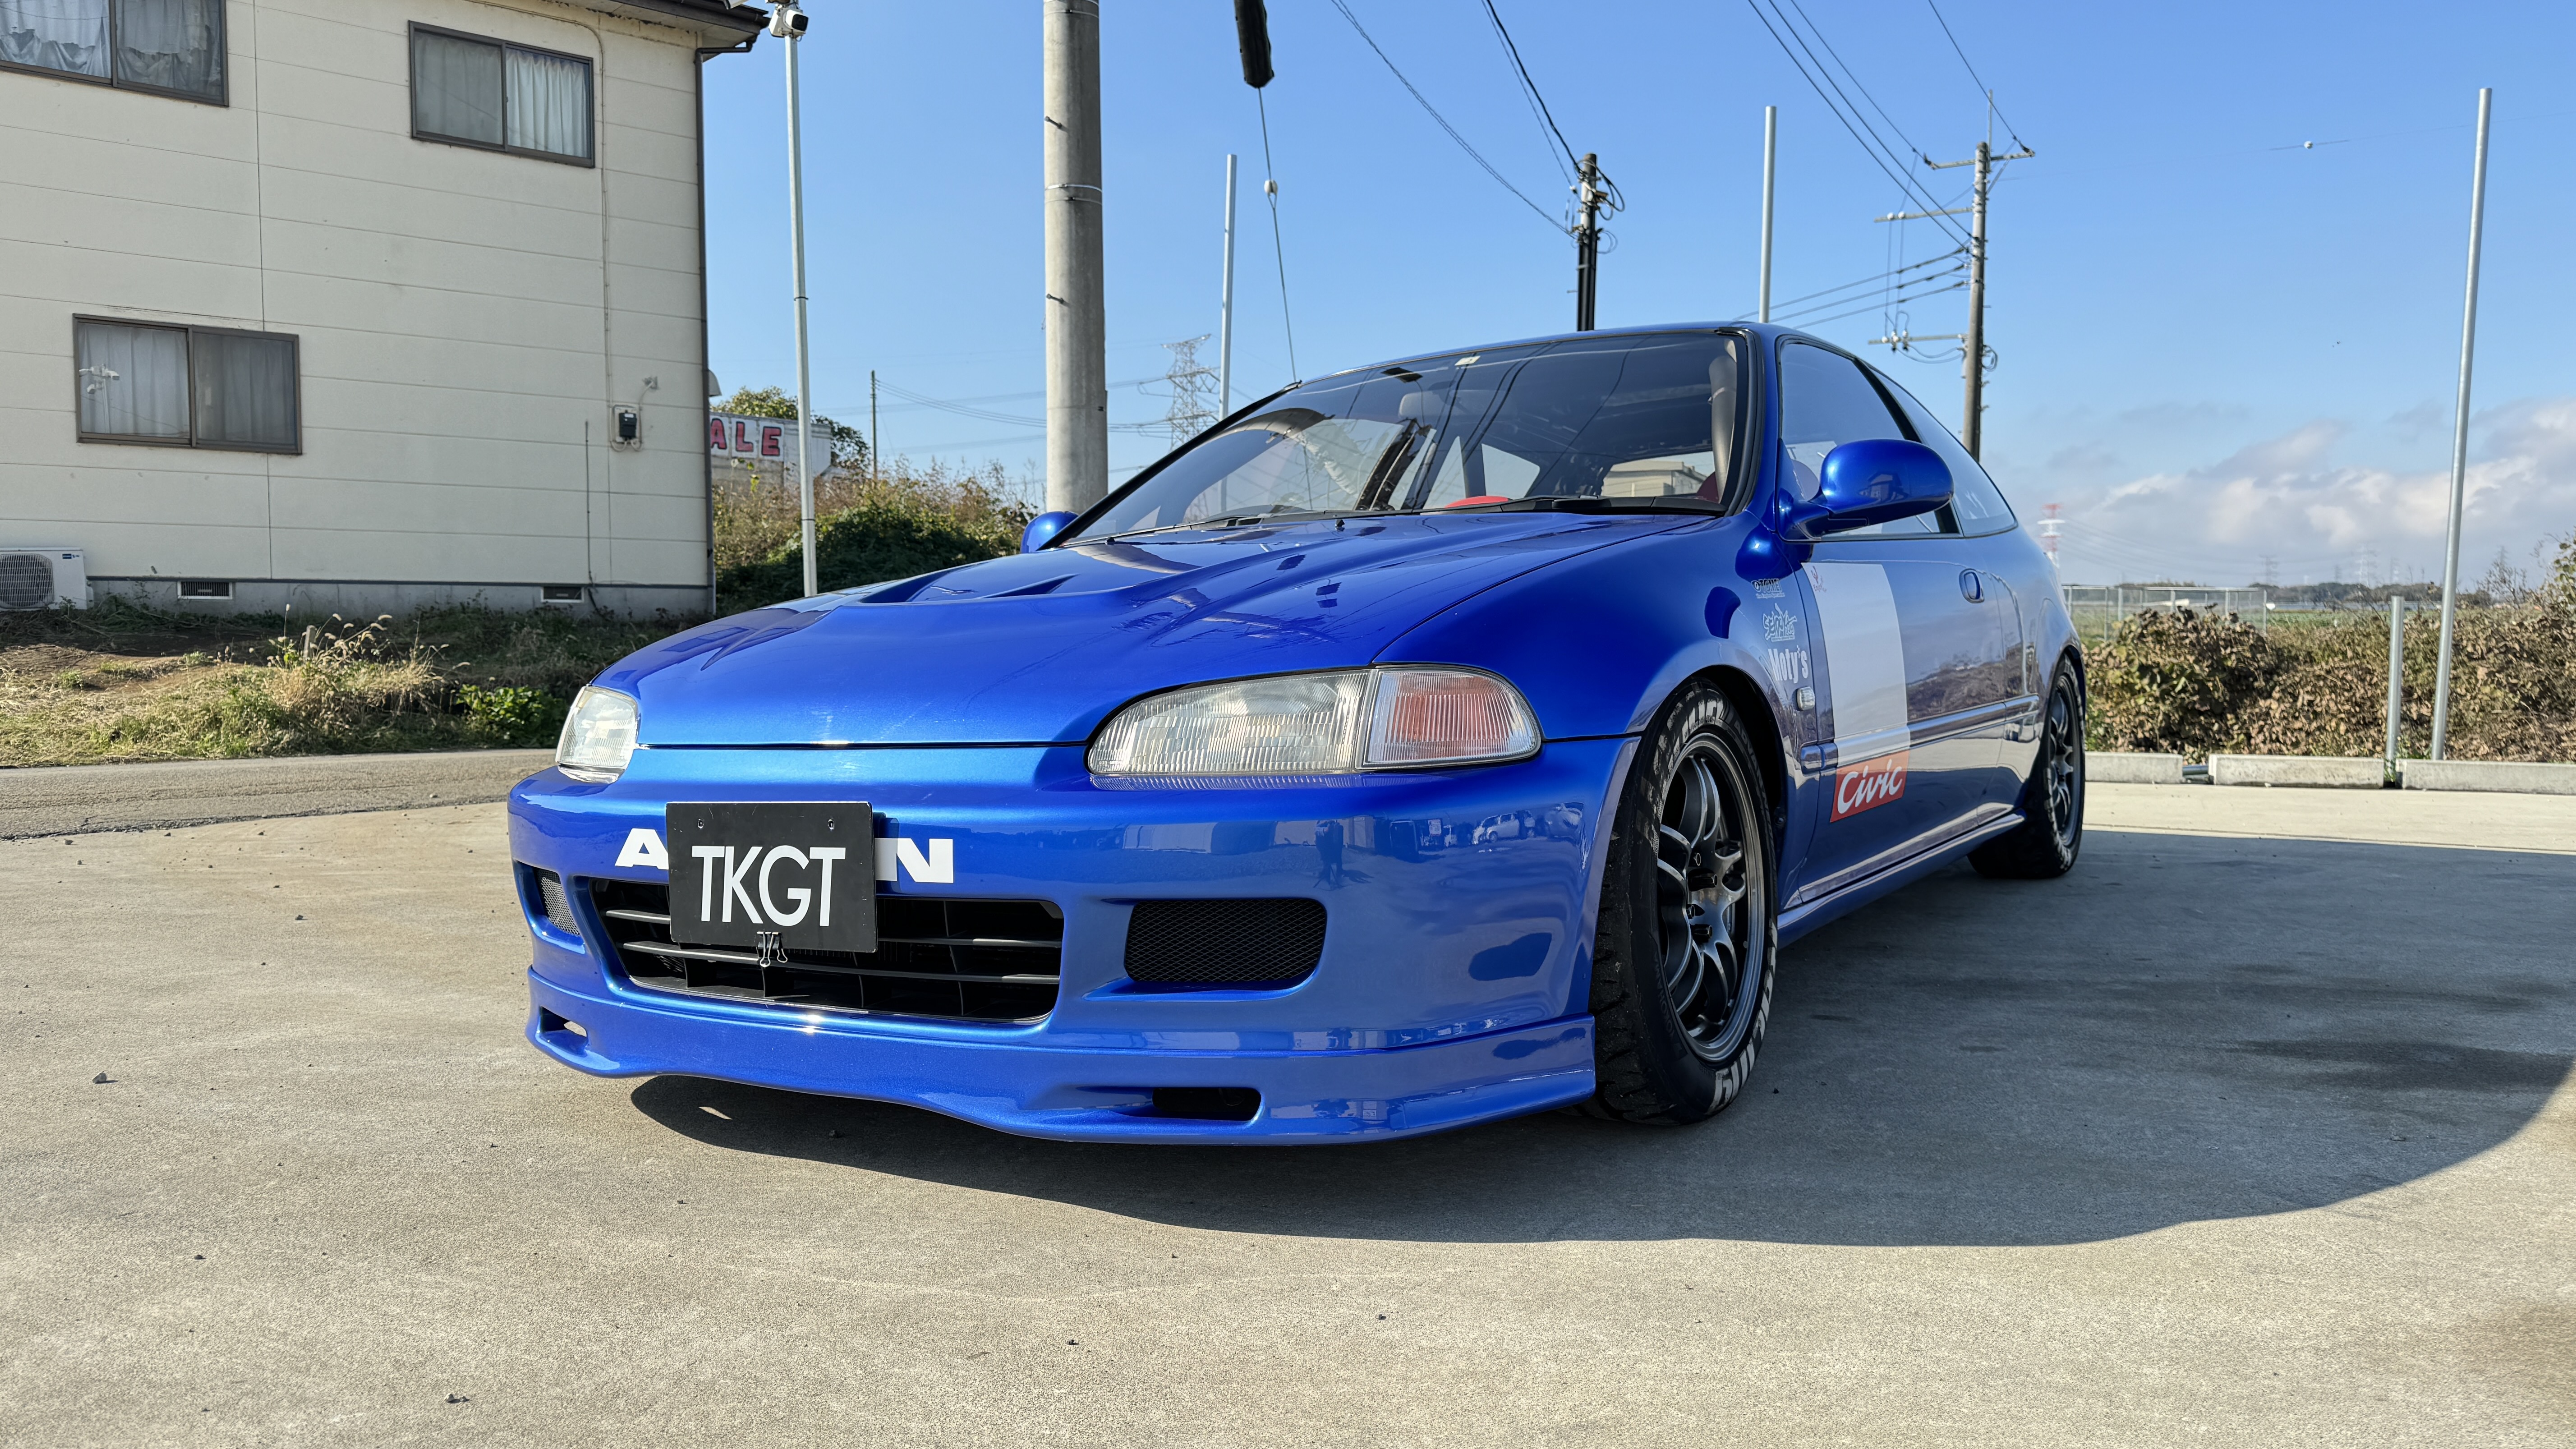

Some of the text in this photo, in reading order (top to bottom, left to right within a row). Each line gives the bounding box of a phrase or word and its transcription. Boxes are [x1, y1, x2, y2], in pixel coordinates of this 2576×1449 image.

[1768, 645, 1808, 683] Moty's
[1837, 759, 1903, 814] Civic
[691, 845, 846, 926] TKGT
